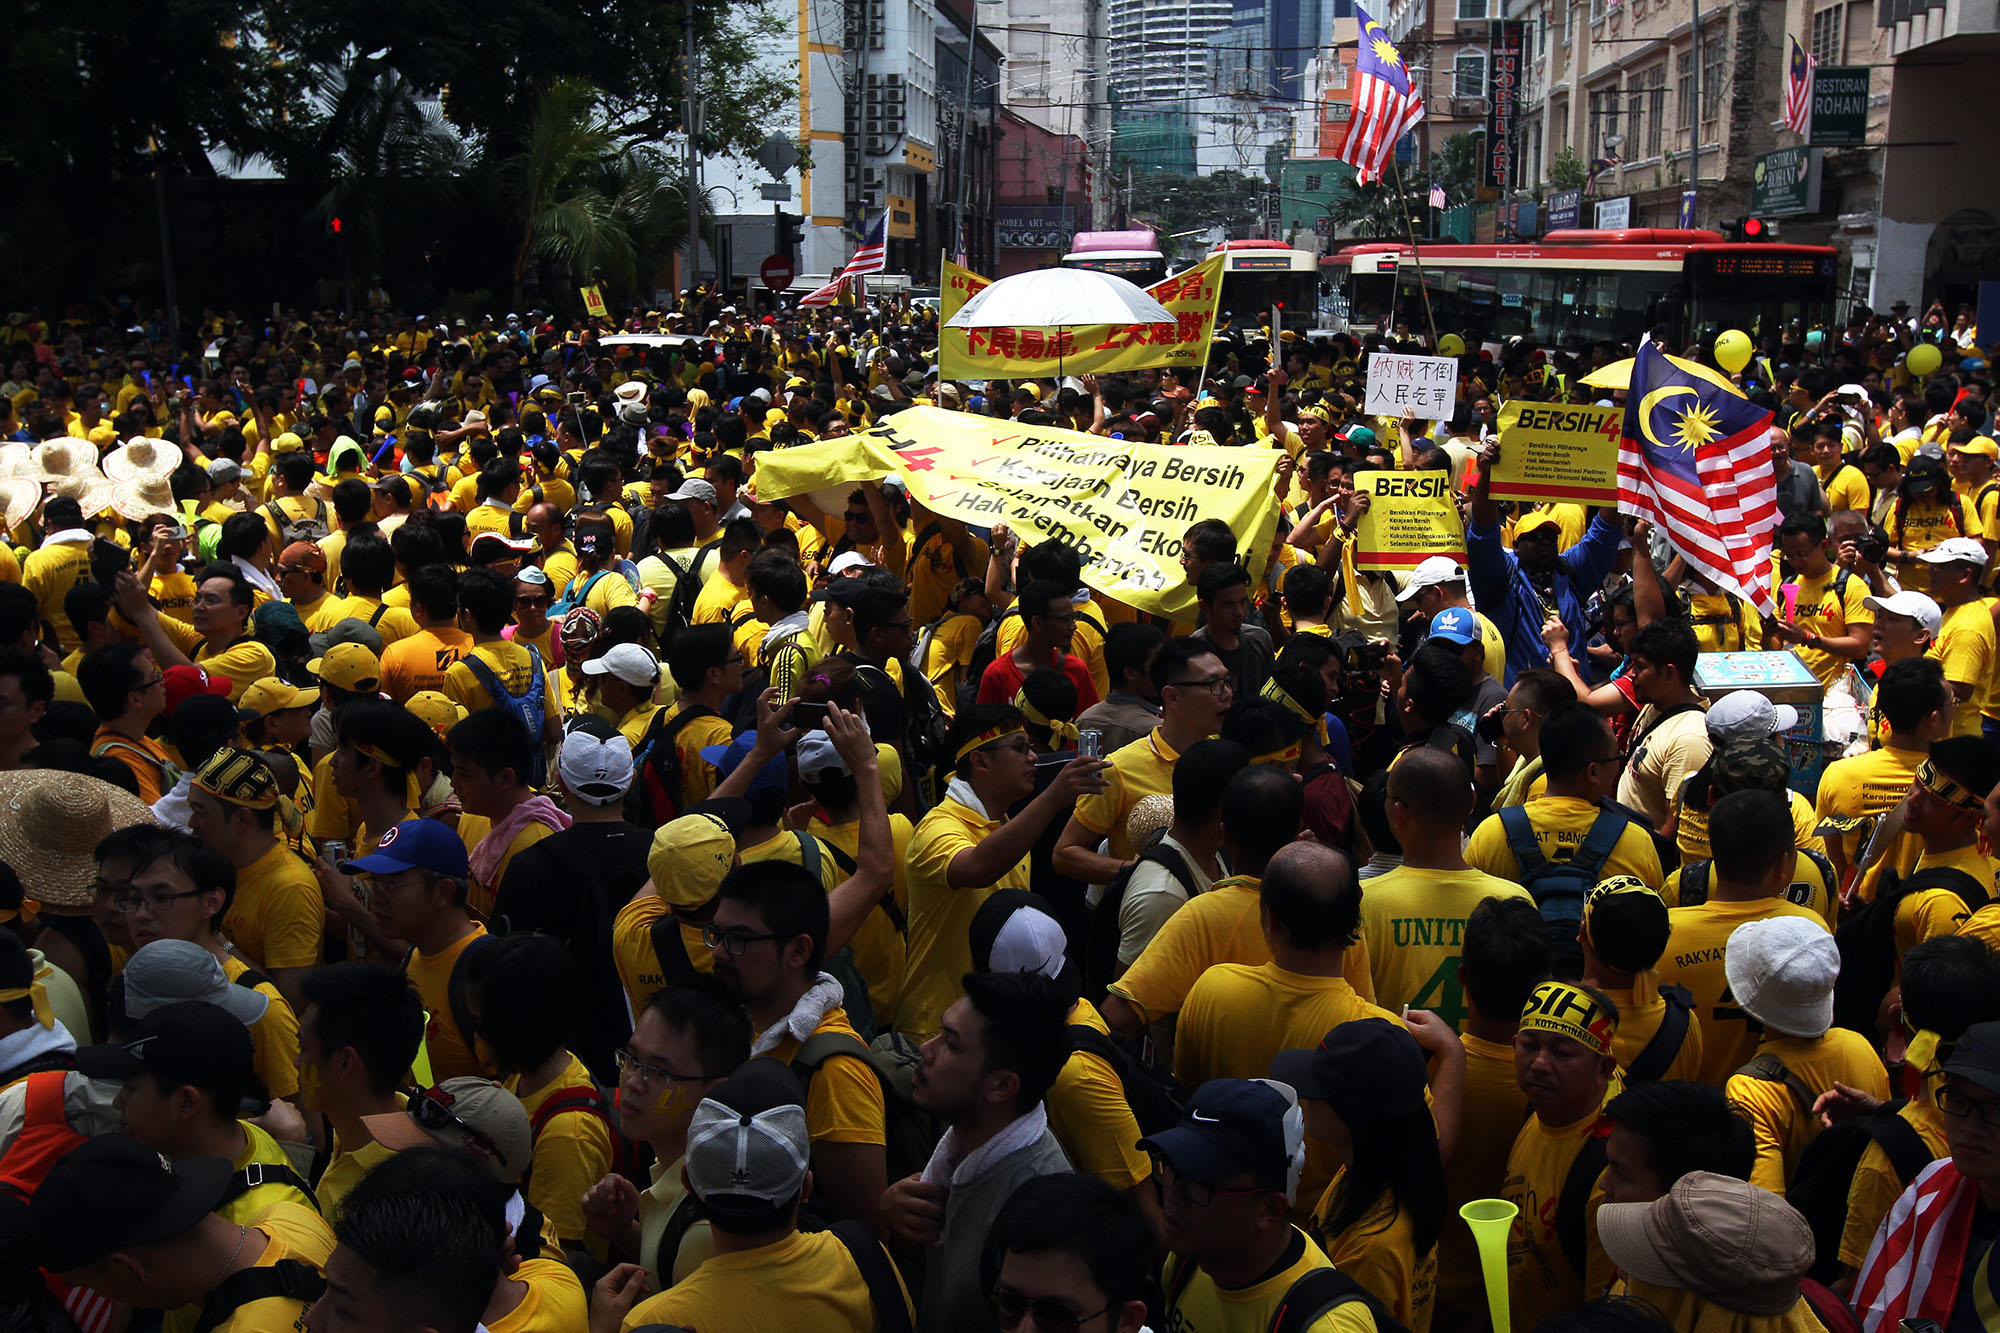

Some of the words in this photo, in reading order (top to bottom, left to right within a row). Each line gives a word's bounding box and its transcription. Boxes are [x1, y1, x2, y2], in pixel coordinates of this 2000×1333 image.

[1494, 57, 1515, 135] NOBEL
[1815, 78, 1867, 94] RESTORAN
[1814, 95, 1866, 115] ROHANI
[1492, 139, 1512, 185] ART
[1766, 150, 1799, 170] RESTORAN
[1767, 167, 1796, 189] ROHANI
[1028, 218, 1043, 227] ART
[1372, 356, 1453, 382] 纳贼不倒
[1371, 383, 1447, 411] 人民吃草
[1517, 408, 1621, 443] BERSIH4
[1527, 450, 1552, 459] Kerajaan
[1553, 451, 1571, 459] Bersih
[1528, 442, 1556, 450] Bersihkan
[1557, 444, 1588, 453] Pilihanraya
[1017, 437, 1158, 480] Pilihanraya
[1162, 457, 1245, 490] Bersih
[1525, 465, 1553, 473] Kukuhkan
[1554, 466, 1582, 474] Demokrasi
[1540, 458, 1572, 466] Membantah
[1524, 472, 1554, 480] Selamatkan
[997, 458, 1111, 498] Kerajaan
[1117, 489, 1199, 522] Bersih
[955, 492, 1009, 514] Hak
[977, 481, 1129, 543] Selamatkan
[1389, 509, 1415, 517] Bersihkan
[1416, 510, 1447, 518] Pilihanraya
[1389, 517, 1413, 525] Kerajaan
[1903, 514, 1954, 529] BERSIH4
[1389, 540, 1421, 548] Selamatkan
[1417, 532, 1445, 540] Demokrasi
[1535, 1018, 1559, 1030] KOTA
[1561, 1023, 1601, 1049] KINABALU
